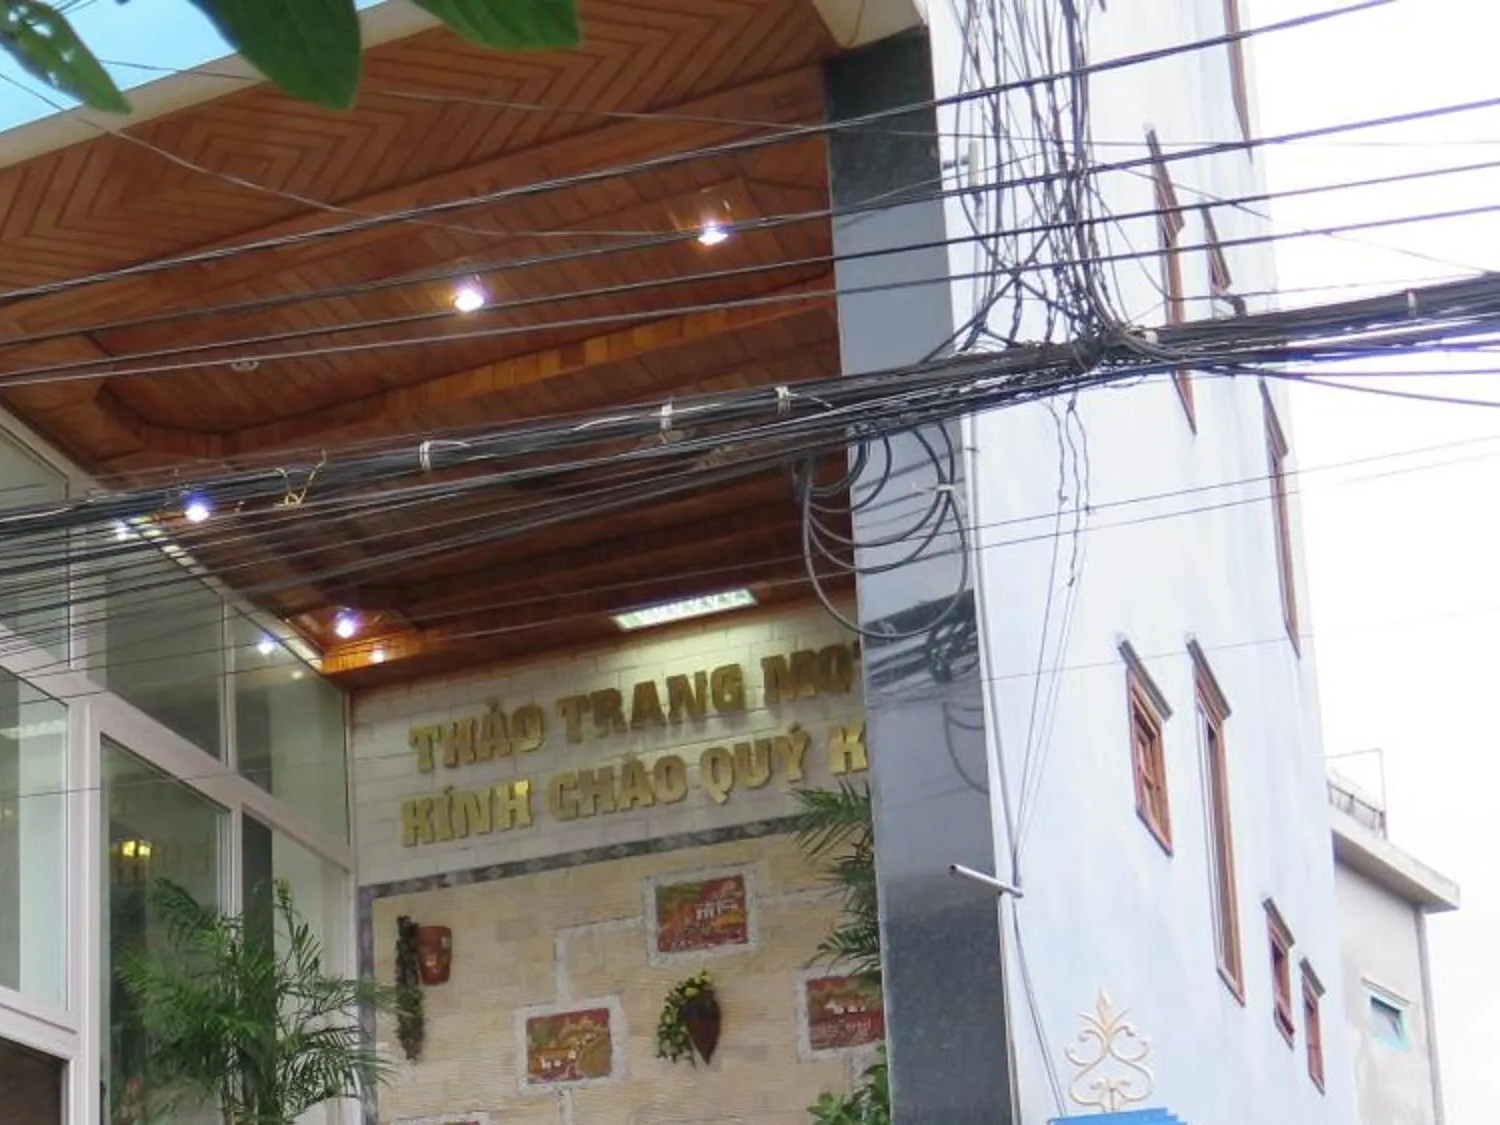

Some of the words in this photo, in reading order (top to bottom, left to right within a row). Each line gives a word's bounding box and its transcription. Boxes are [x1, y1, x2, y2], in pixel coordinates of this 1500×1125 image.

[409, 697, 545, 774] THẢO
[556, 664, 747, 744] TRANG
[760, 640, 861, 703] MO
[402, 778, 533, 848] KÍNH
[701, 722, 811, 805] QUÝ
